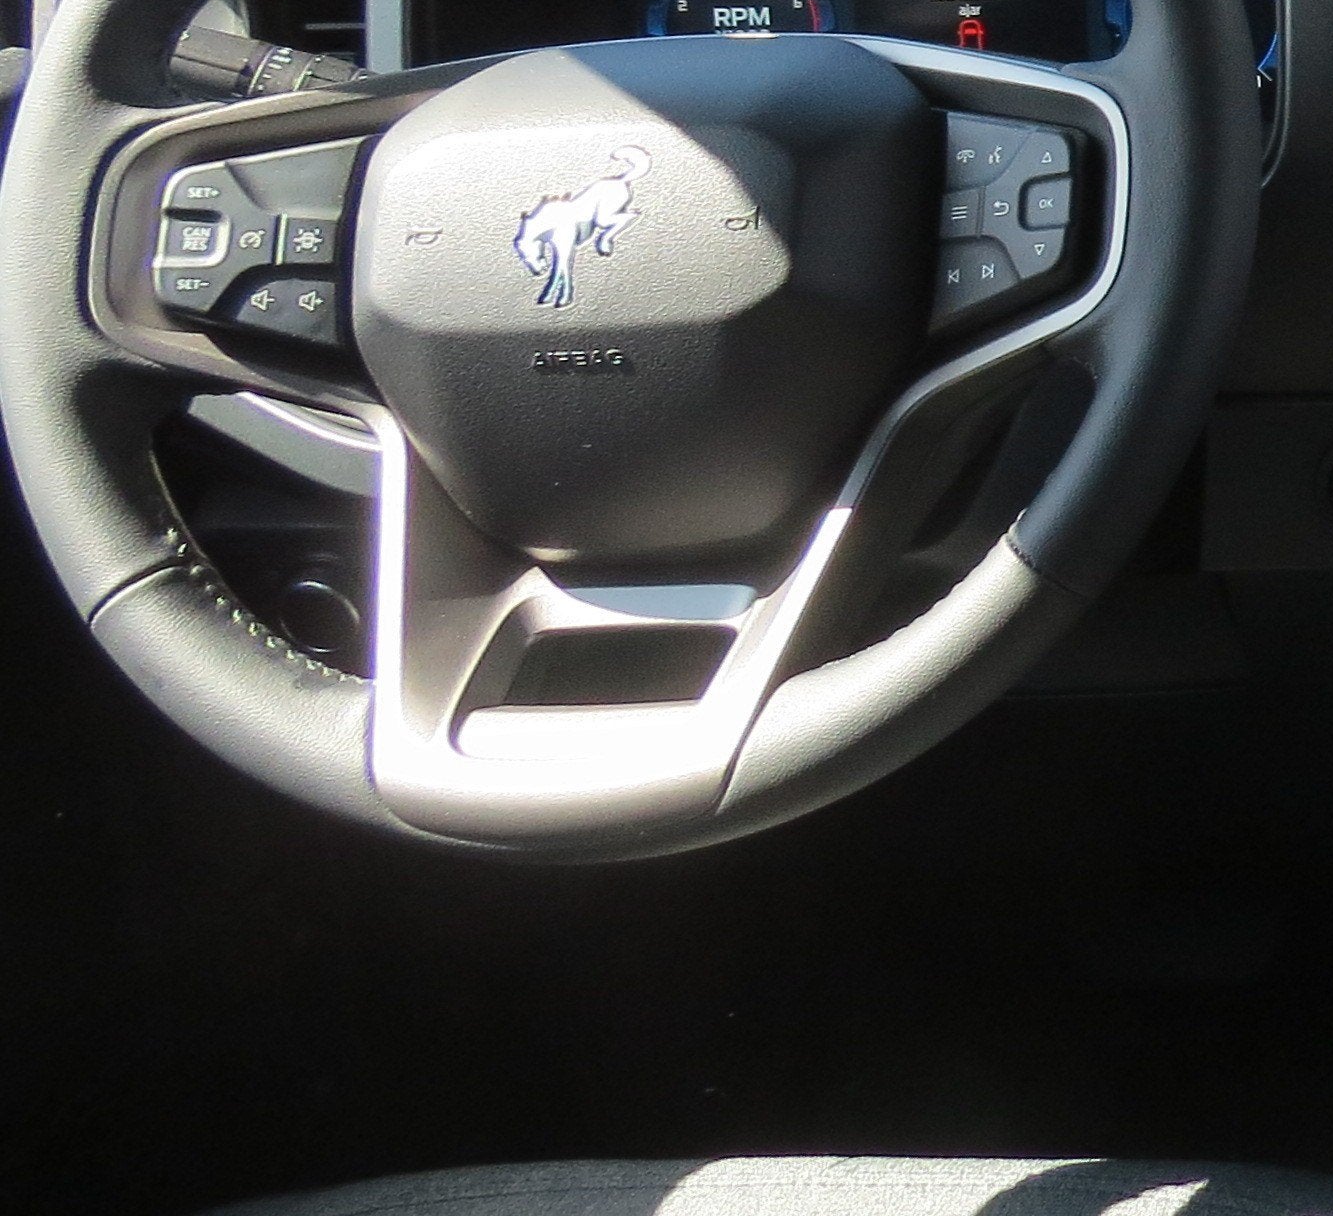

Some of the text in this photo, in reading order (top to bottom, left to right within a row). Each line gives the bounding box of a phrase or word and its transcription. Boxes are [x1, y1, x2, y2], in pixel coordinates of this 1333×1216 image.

[676, 0, 689, 12] 2
[958, 4, 982, 18] ajar
[713, 6, 771, 28] RPM
[1038, 197, 1056, 211] OK
[182, 226, 212, 240] CAN
[530, 347, 624, 369] AIRBAG
